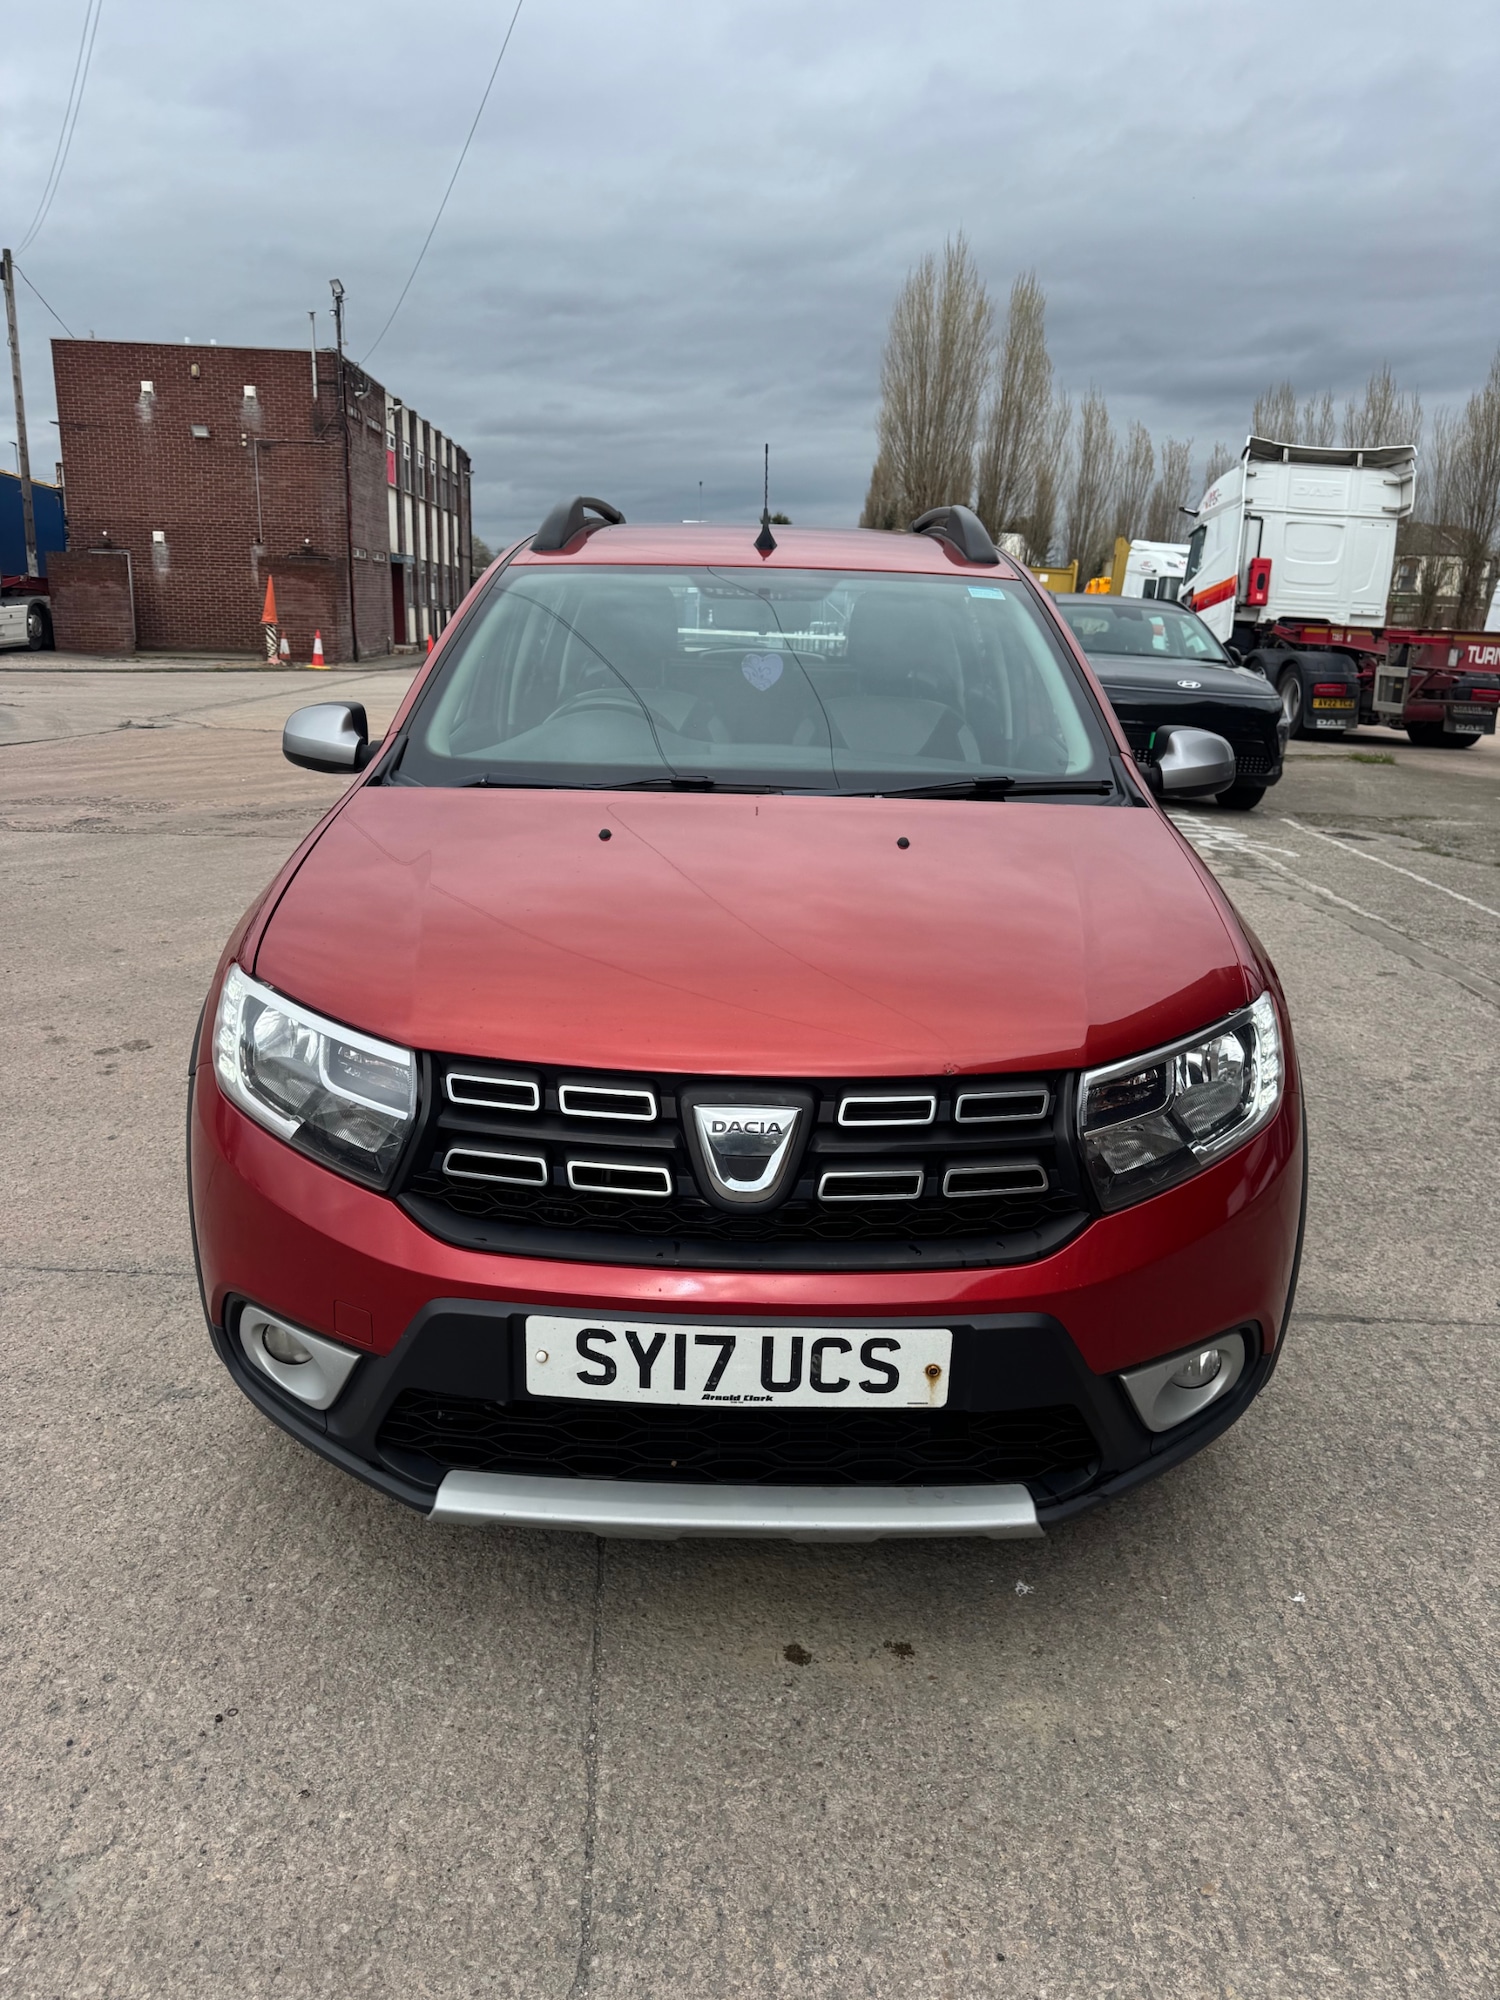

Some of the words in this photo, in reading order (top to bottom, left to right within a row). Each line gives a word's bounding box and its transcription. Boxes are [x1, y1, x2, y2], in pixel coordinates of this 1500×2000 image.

[1293, 486, 1343, 497] DAF
[1455, 723, 1485, 731] DAF
[712, 1121, 783, 1135] DACIA
[576, 1328, 736, 1391] SY17
[760, 1336, 901, 1393] UCS
[701, 1393, 741, 1401] Arnold
